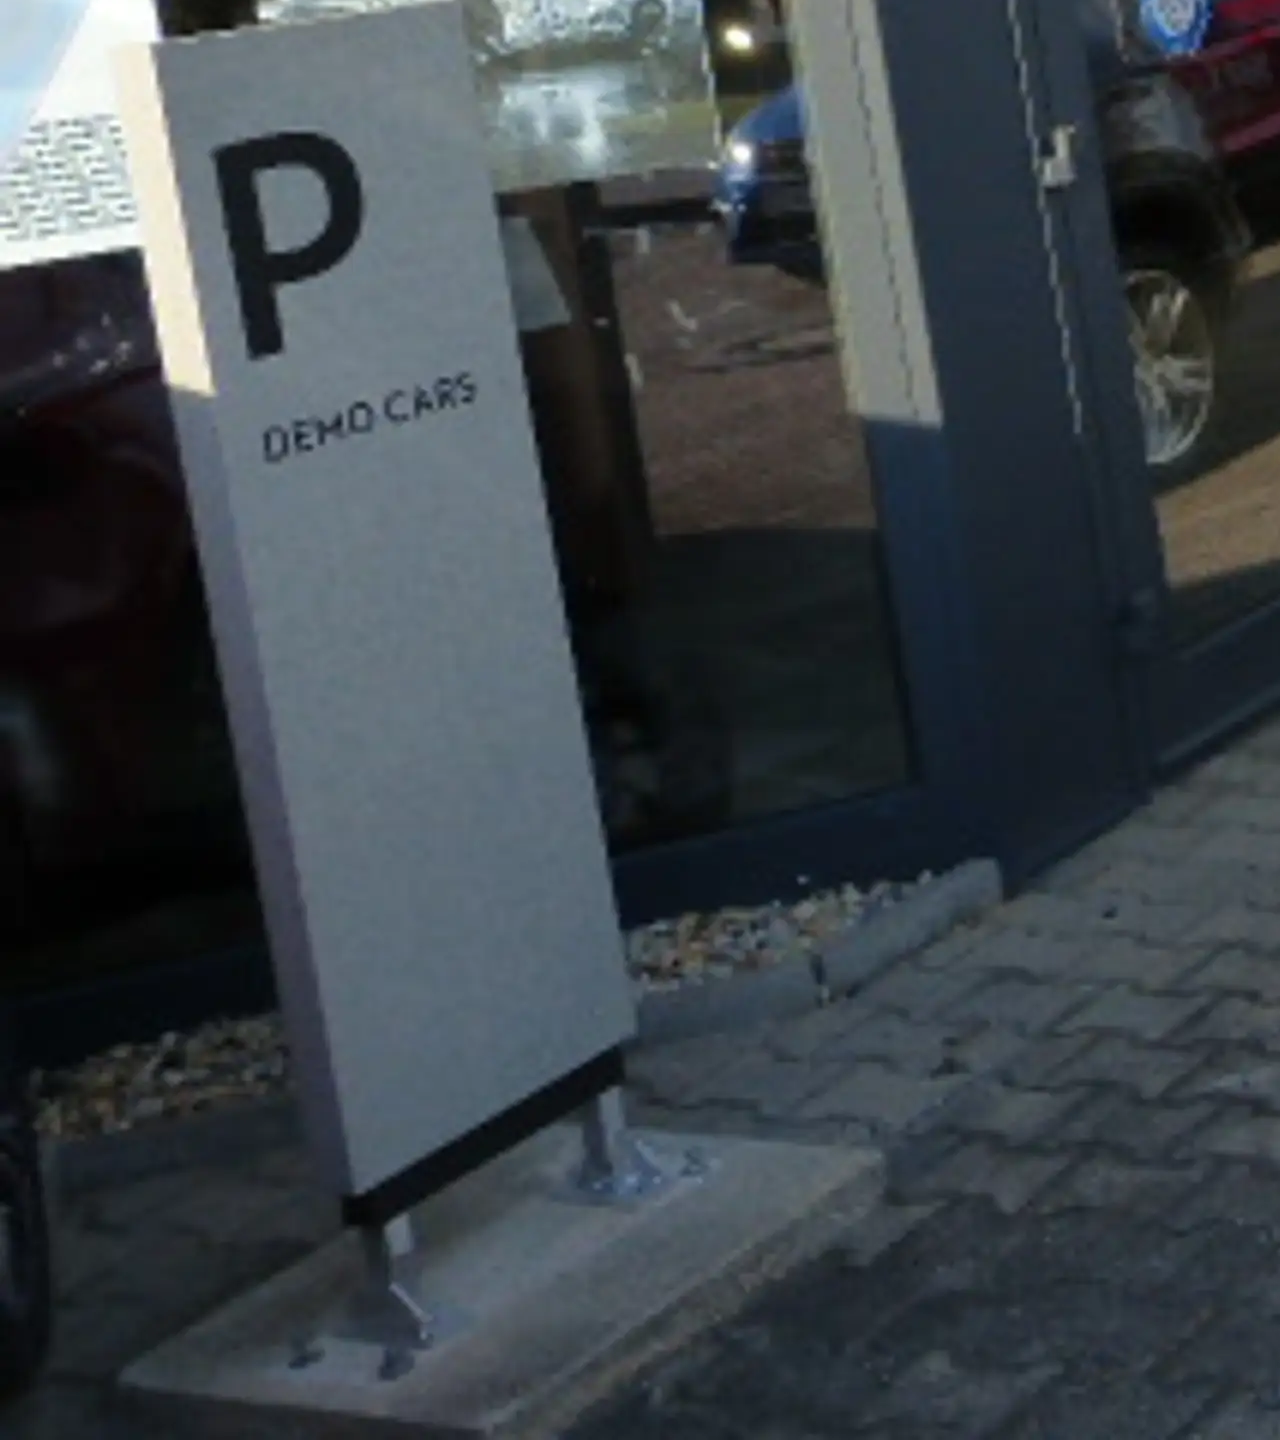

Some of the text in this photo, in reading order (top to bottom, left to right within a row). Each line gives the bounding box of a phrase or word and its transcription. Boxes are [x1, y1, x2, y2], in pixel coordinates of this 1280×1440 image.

[210, 131, 362, 360] P
[262, 372, 476, 462] DEMO CARS
